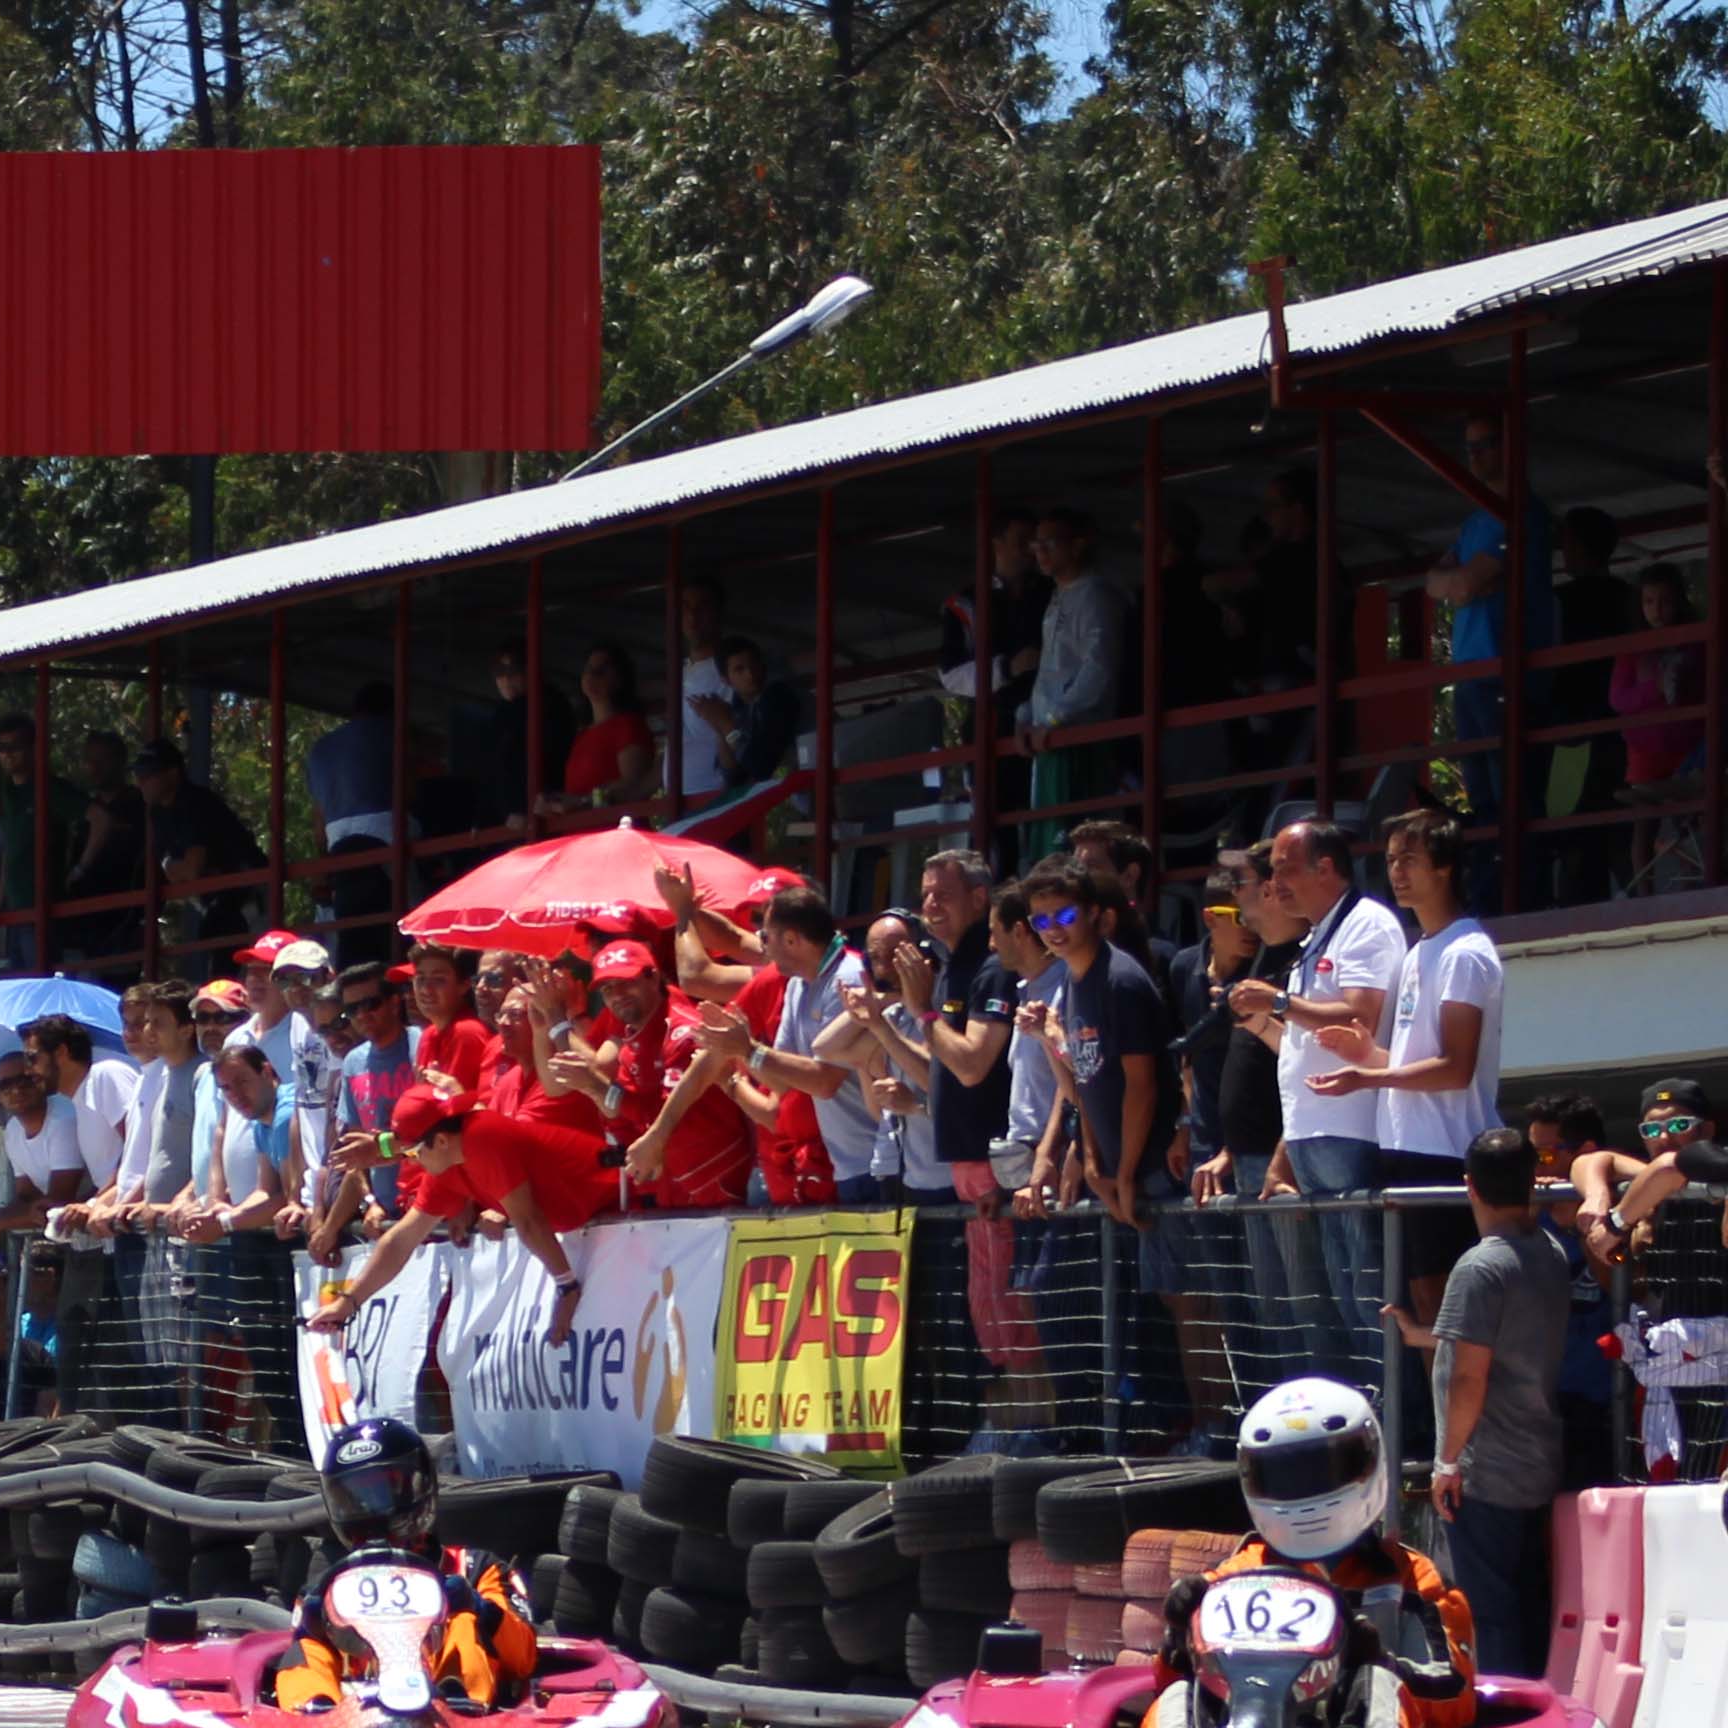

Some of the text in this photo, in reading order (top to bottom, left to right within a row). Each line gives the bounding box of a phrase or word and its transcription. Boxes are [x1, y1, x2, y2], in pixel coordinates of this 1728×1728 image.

[735, 1249, 903, 1364] GAS
[468, 1327, 625, 1412] multicare
[725, 1388, 892, 1429] RACING TEAM
[357, 1575, 411, 1610] 93
[1213, 1589, 1317, 1641] 162
